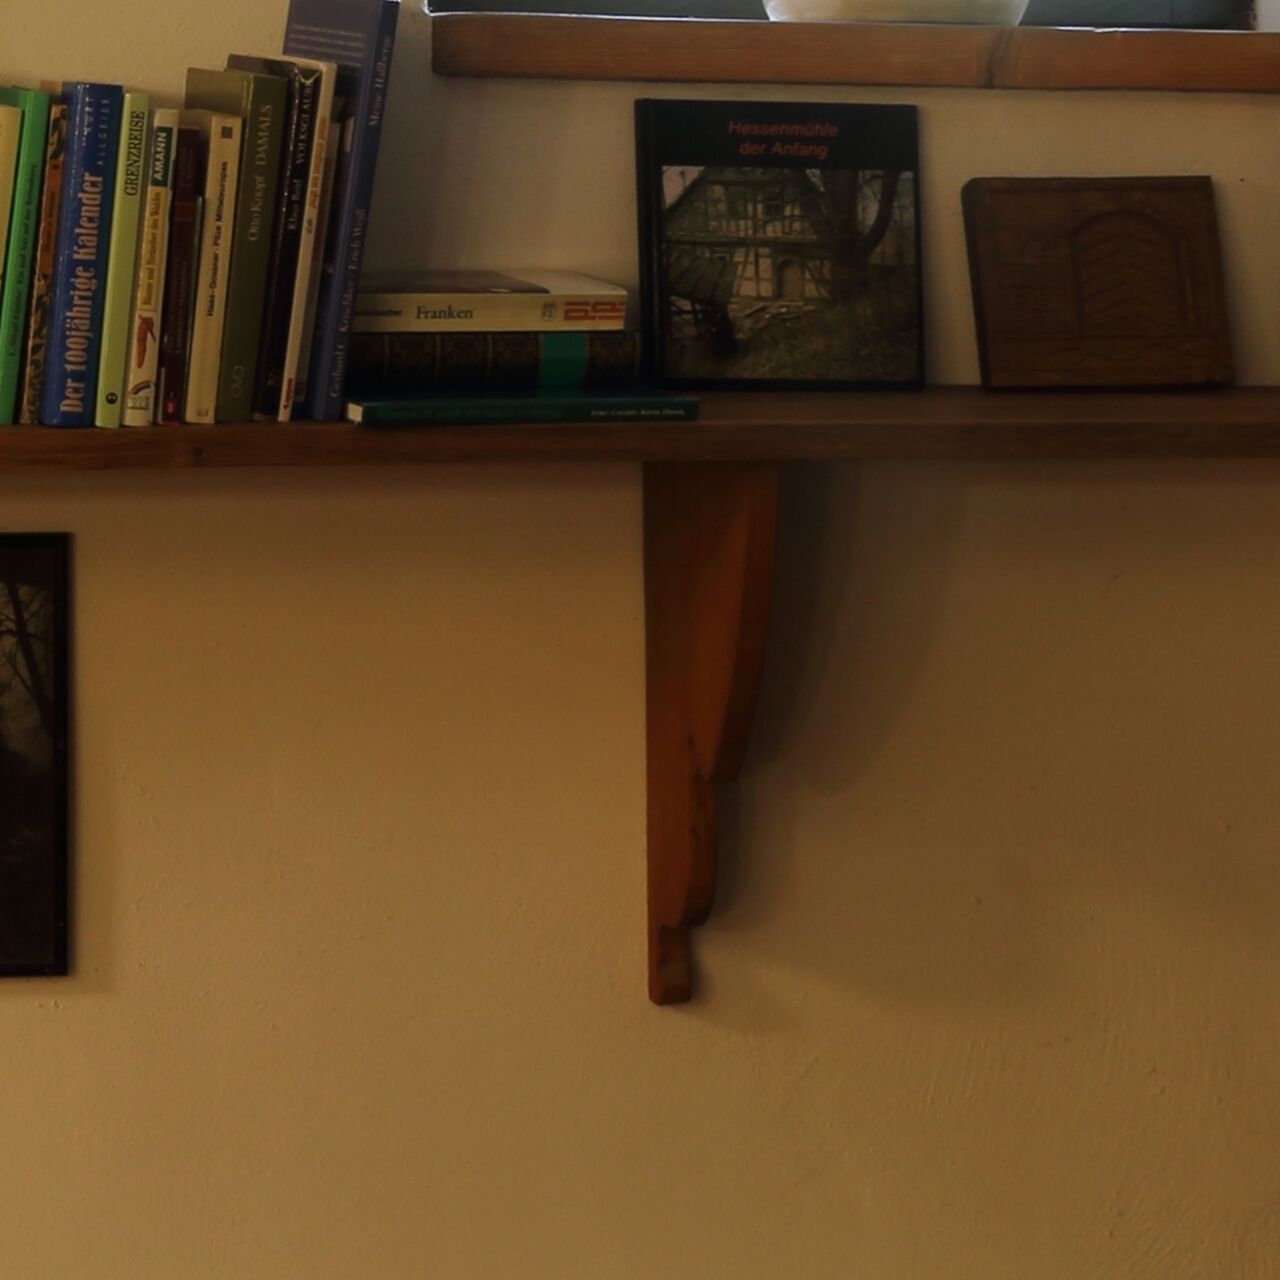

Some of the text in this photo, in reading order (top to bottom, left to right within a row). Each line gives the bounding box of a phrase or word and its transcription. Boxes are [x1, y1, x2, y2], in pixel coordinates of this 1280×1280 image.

[256, 104, 272, 165] DAMALS
[728, 121, 839, 137] Hessenmühle
[739, 141, 828, 160] der Anfang
[124, 111, 145, 196] GRENZREISE
[154, 132, 167, 180] AMANN
[60, 172, 103, 412] Der 100jährige Kalender
[416, 304, 474, 320] Franken
